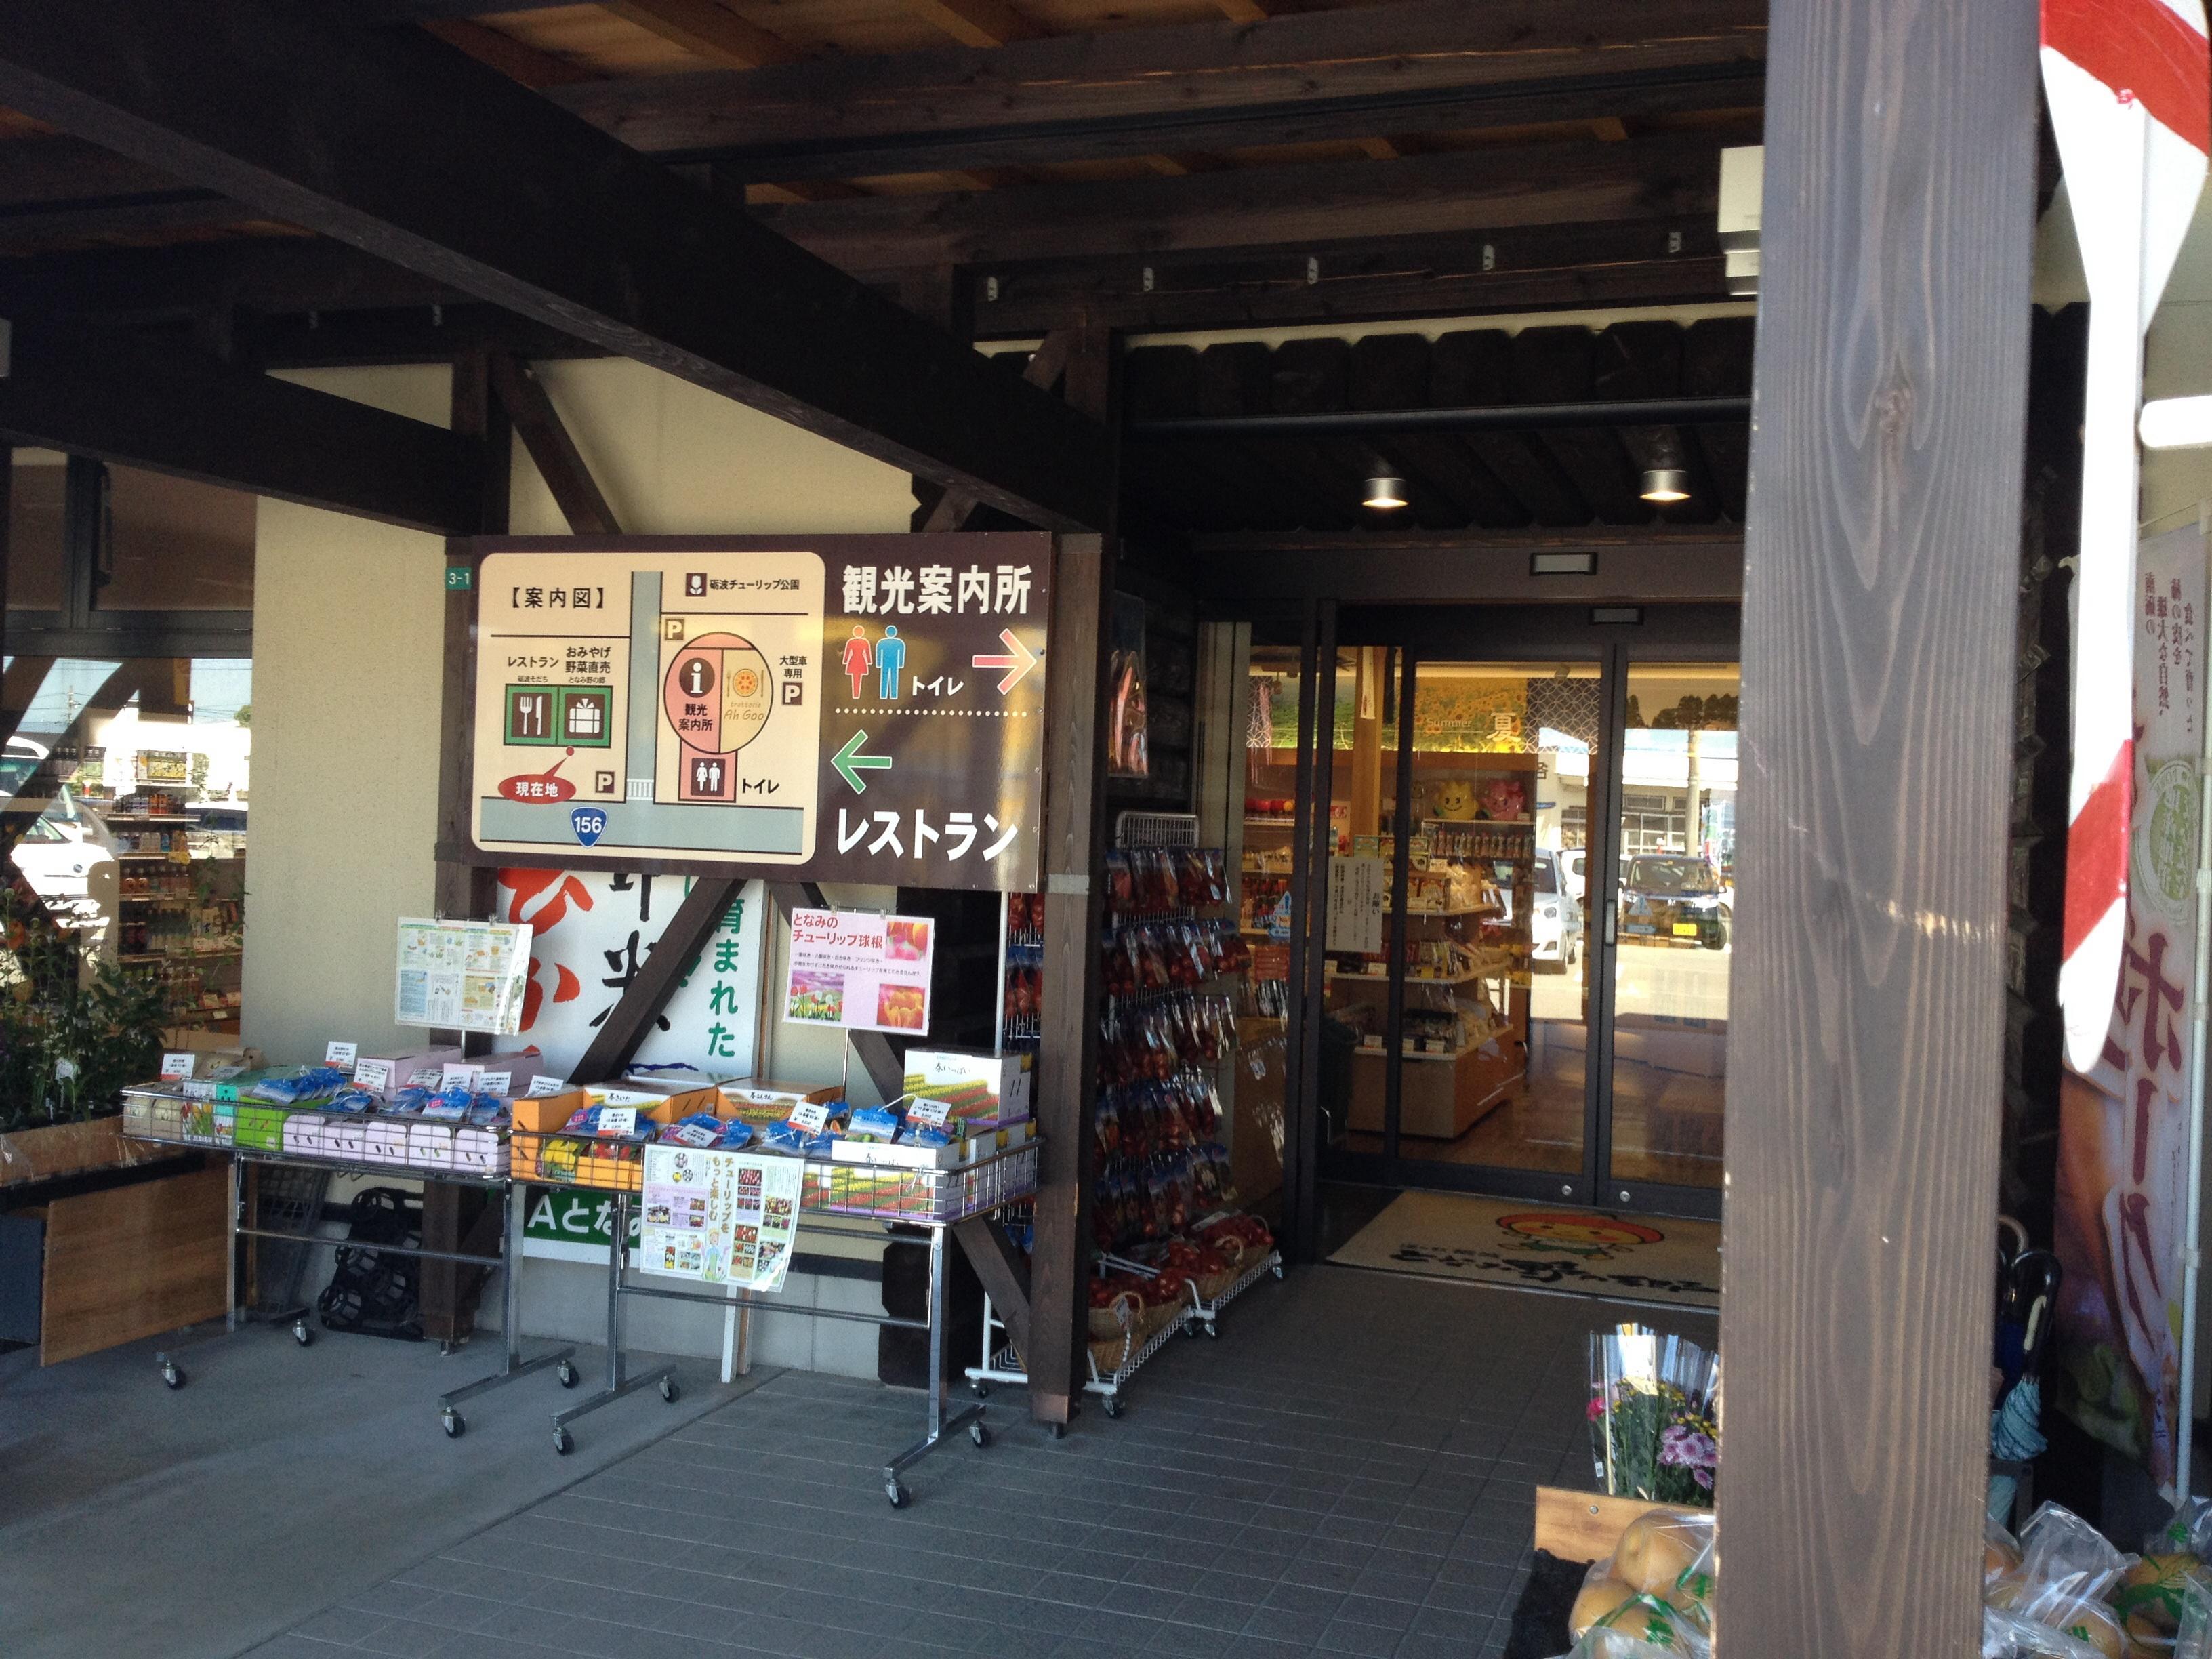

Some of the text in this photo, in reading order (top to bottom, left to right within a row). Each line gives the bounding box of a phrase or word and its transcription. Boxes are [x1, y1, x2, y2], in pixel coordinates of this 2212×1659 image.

[449, 572, 470, 585] 3-1
[710, 579, 800, 591] 砺波チューリップ公園
[842, 565, 1032, 615] 観光案内所
[668, 621, 682, 638] P
[566, 646, 611, 659] おみやげ
[508, 656, 559, 668] レストラン
[565, 661, 611, 674] 野菜直売
[779, 656, 807, 667] 大型車
[517, 675, 548, 683] 砺波そだち
[784, 669, 802, 679] 専用
[912, 676, 964, 696] トイレ
[785, 686, 800, 702] P
[684, 703, 708, 716] 観光
[724, 709, 764, 720] Ah Goo
[678, 718, 713, 732] 案内所
[1427, 718, 1472, 728] Summer
[1486, 712, 1522, 743] 夏
[516, 782, 558, 796] 現在地
[598, 774, 613, 790] P
[742, 779, 780, 795] トイレ
[574, 815, 602, 833] 156
[838, 808, 1018, 861] レストラン
[793, 913, 838, 928] となみの
[793, 930, 883, 949] チューリップ球根
[709, 1155, 720, 1221] もっと楽しむ
[721, 1158, 734, 1234] チューリップを
